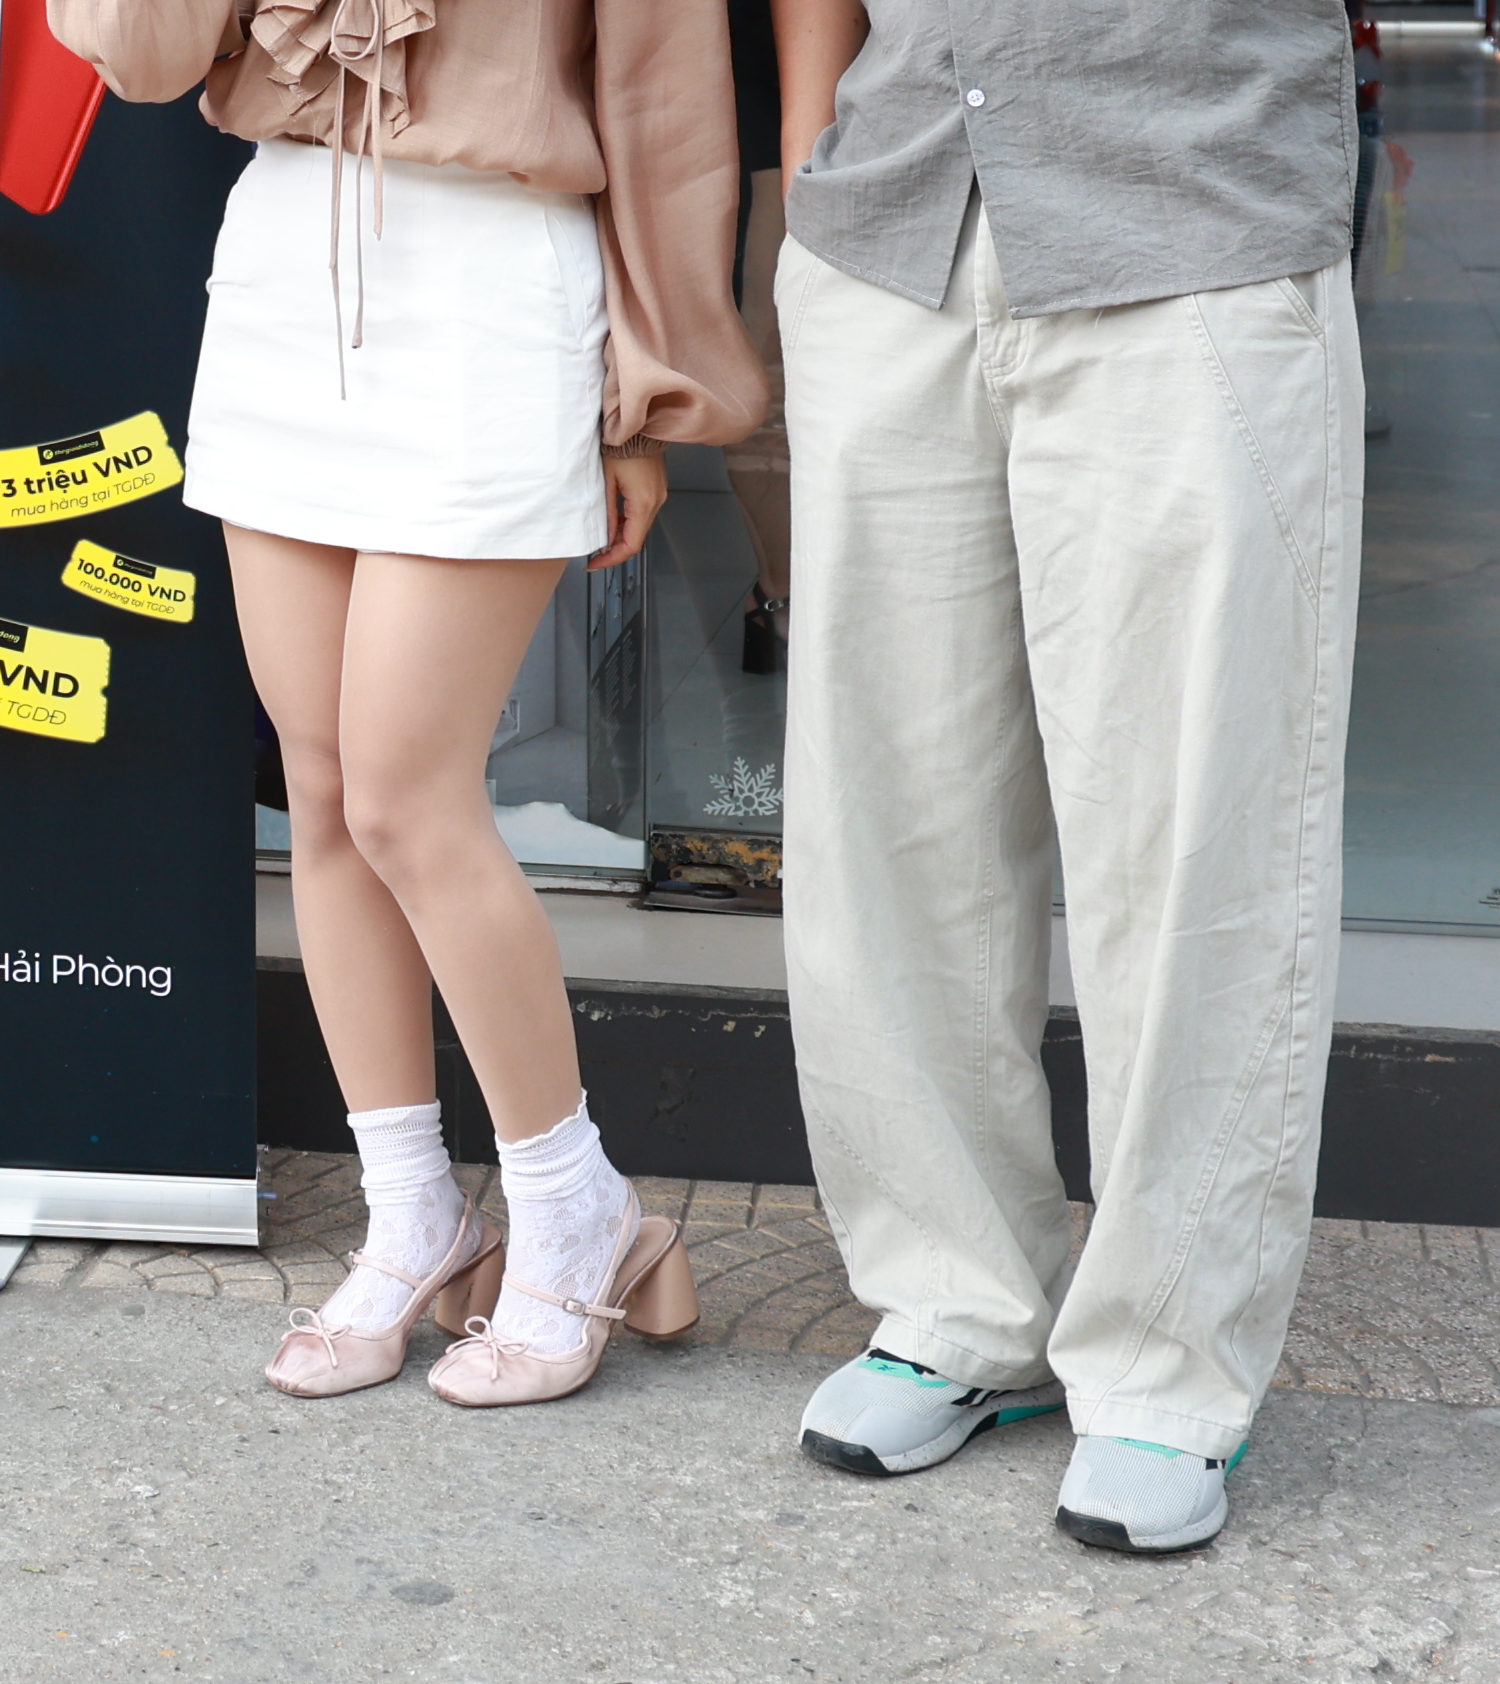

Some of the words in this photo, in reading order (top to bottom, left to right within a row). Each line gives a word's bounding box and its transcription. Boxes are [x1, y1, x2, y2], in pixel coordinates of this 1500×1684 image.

[1, 478, 17, 498] 3
[24, 469, 89, 496] triệu
[92, 445, 153, 478] VND
[11, 503, 46, 518] mua
[49, 494, 89, 513] hàng
[92, 488, 111, 504] tại
[76, 558, 142, 594] 100.000
[147, 584, 186, 603] VND
[51, 953, 172, 998] Phòng
